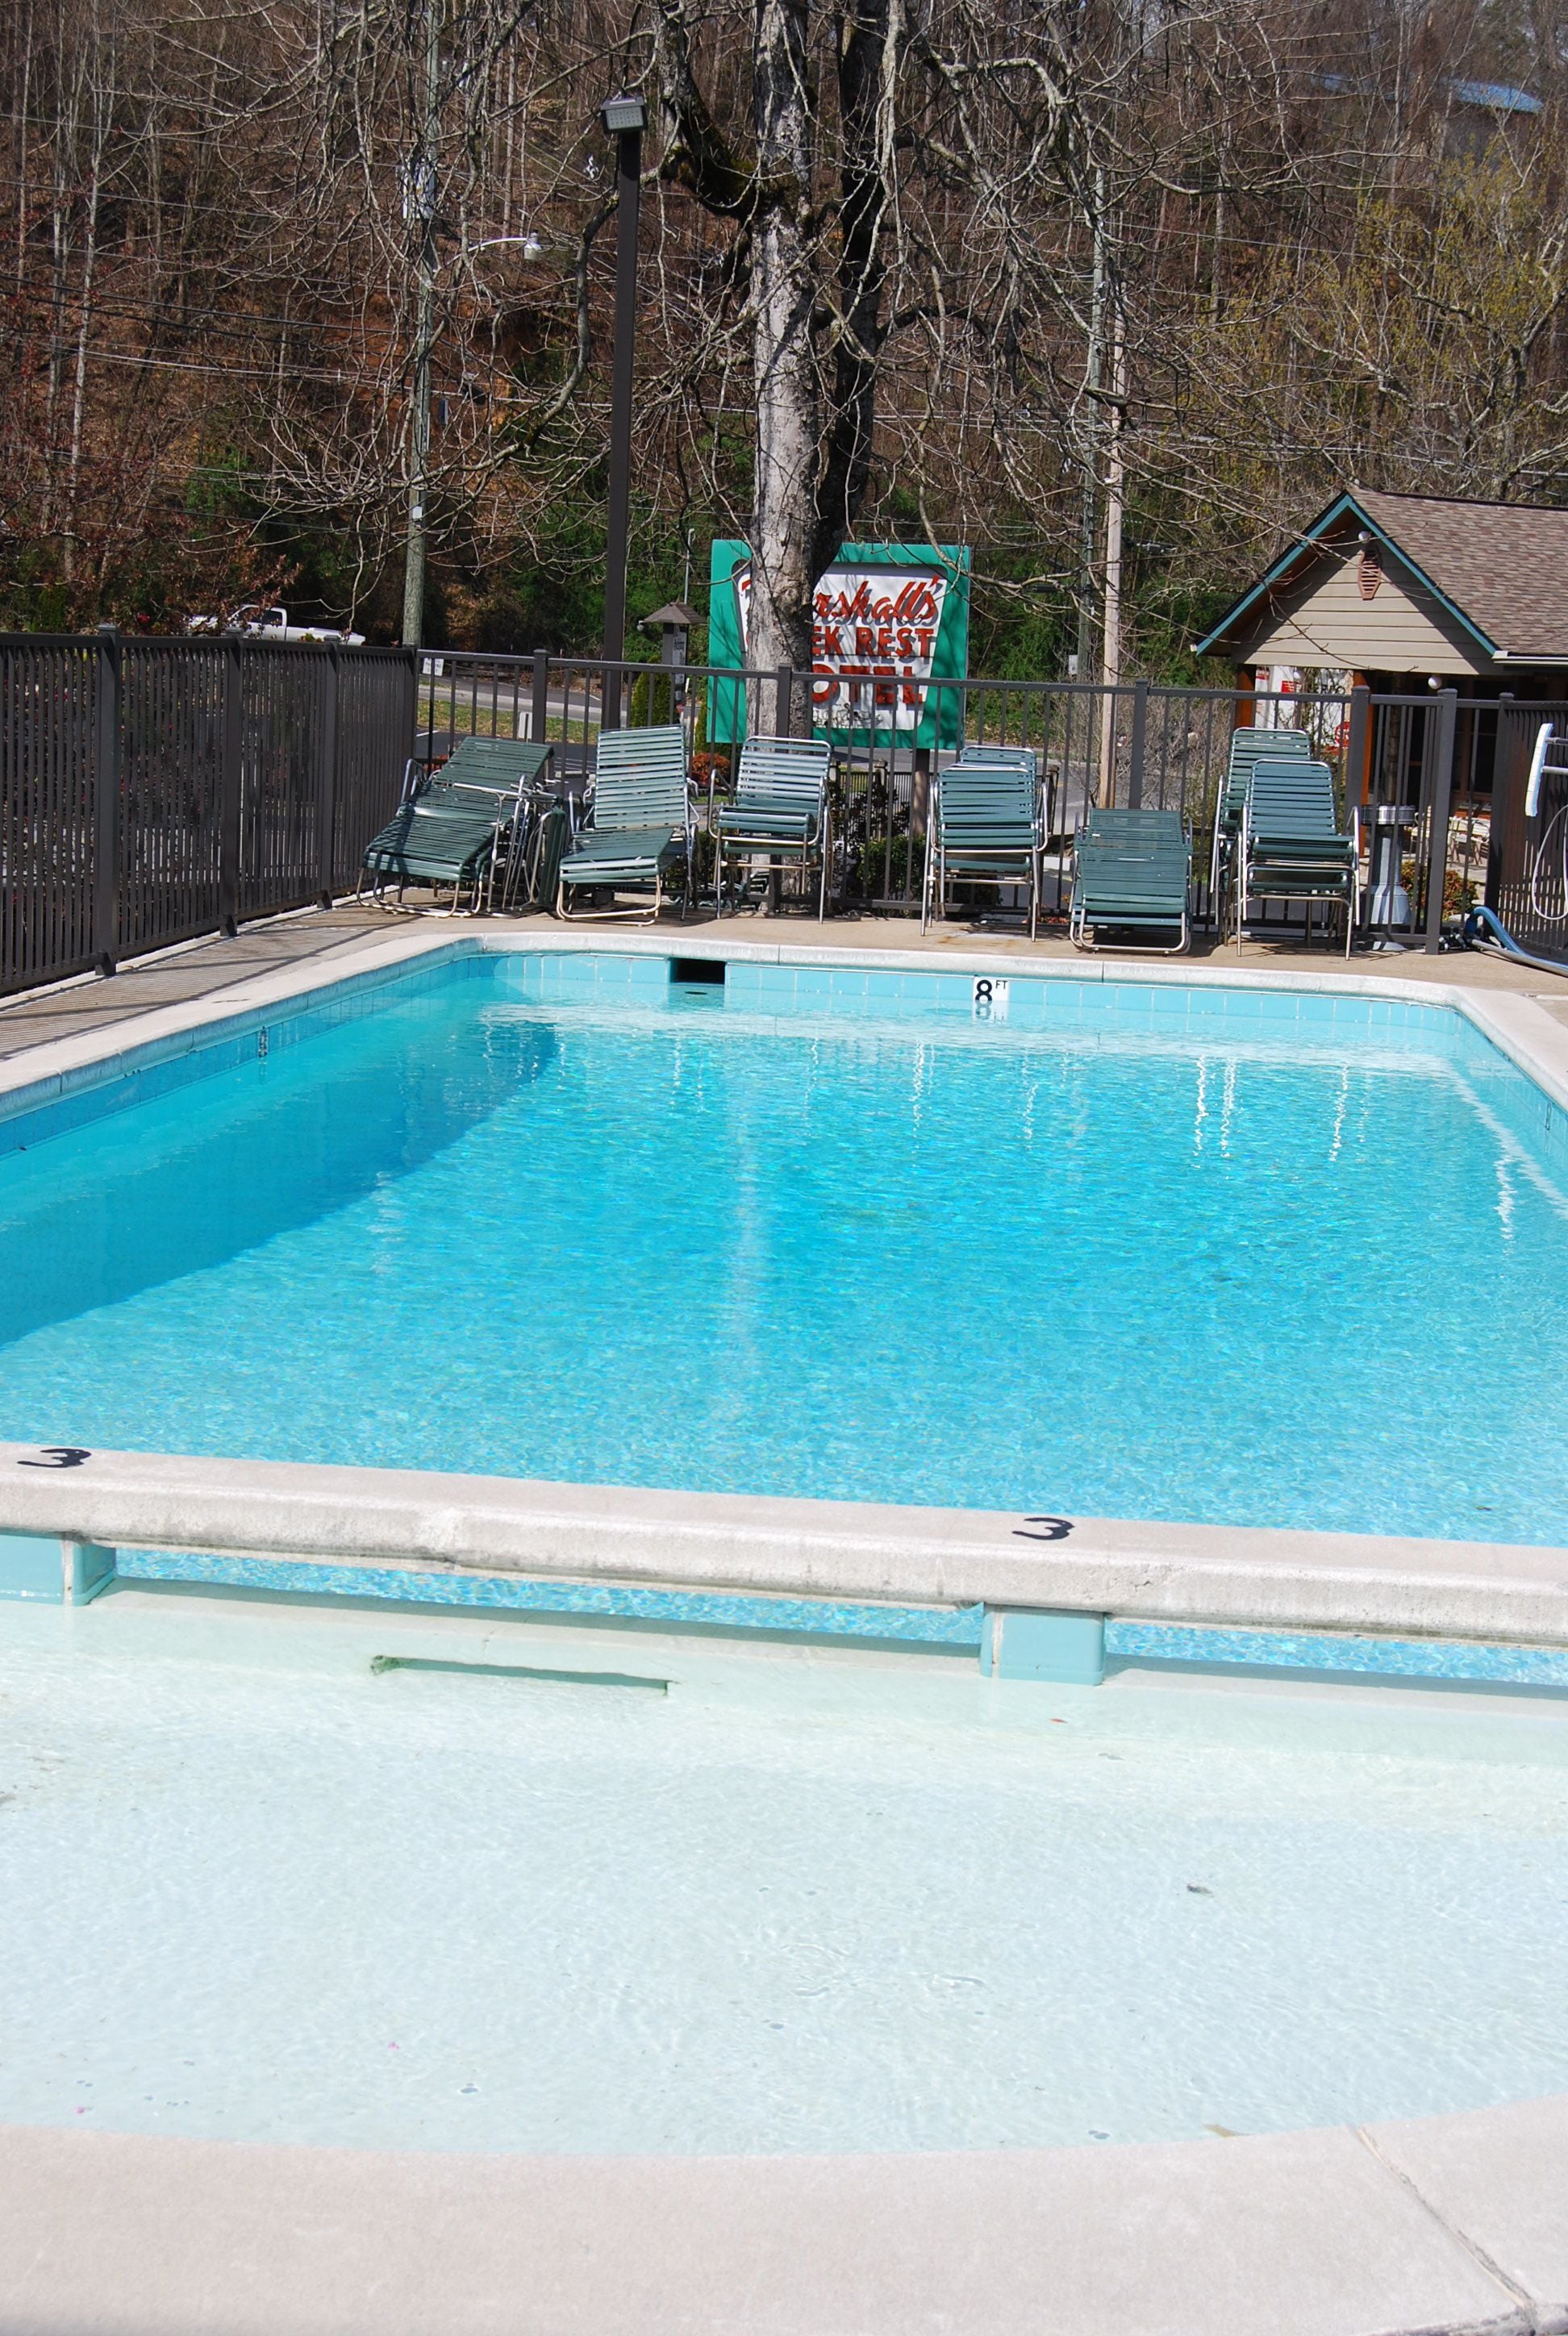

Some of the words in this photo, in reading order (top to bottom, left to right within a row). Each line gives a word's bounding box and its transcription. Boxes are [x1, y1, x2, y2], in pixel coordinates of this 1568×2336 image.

[812, 574, 941, 626] rshall's
[855, 627, 934, 657] REST
[812, 663, 924, 705] OTEL
[975, 979, 993, 1003] 8
[995, 979, 1008, 990] FT
[16, 1448, 92, 1468] 3
[1011, 1517, 1075, 1540] 3
